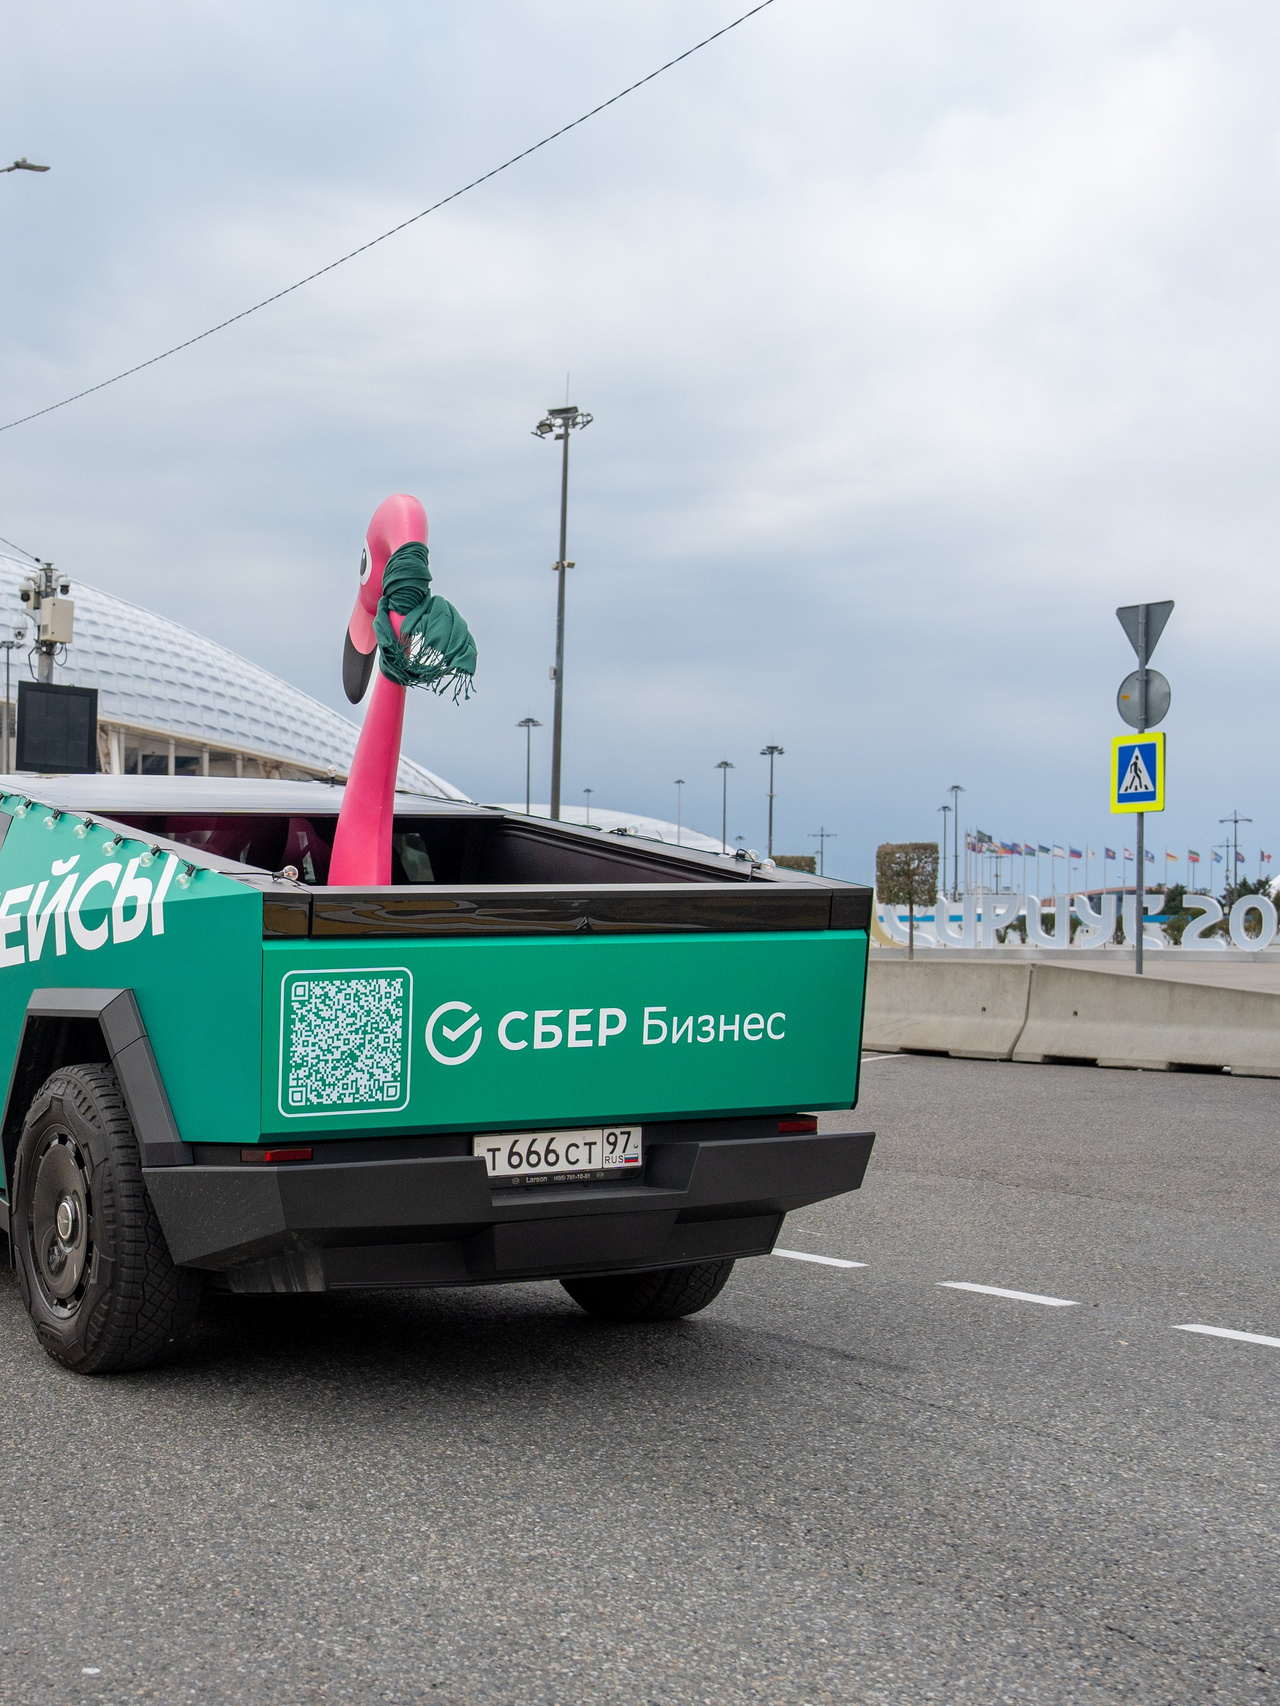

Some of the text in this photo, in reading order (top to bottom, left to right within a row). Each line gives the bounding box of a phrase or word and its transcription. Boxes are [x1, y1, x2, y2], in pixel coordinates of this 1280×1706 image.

[498, 1006, 786, 1051] СБЕР Бизнес
[605, 1130, 632, 1155] 97
[604, 1154, 624, 1165] RUS
[525, 1175, 548, 1184] Larson
